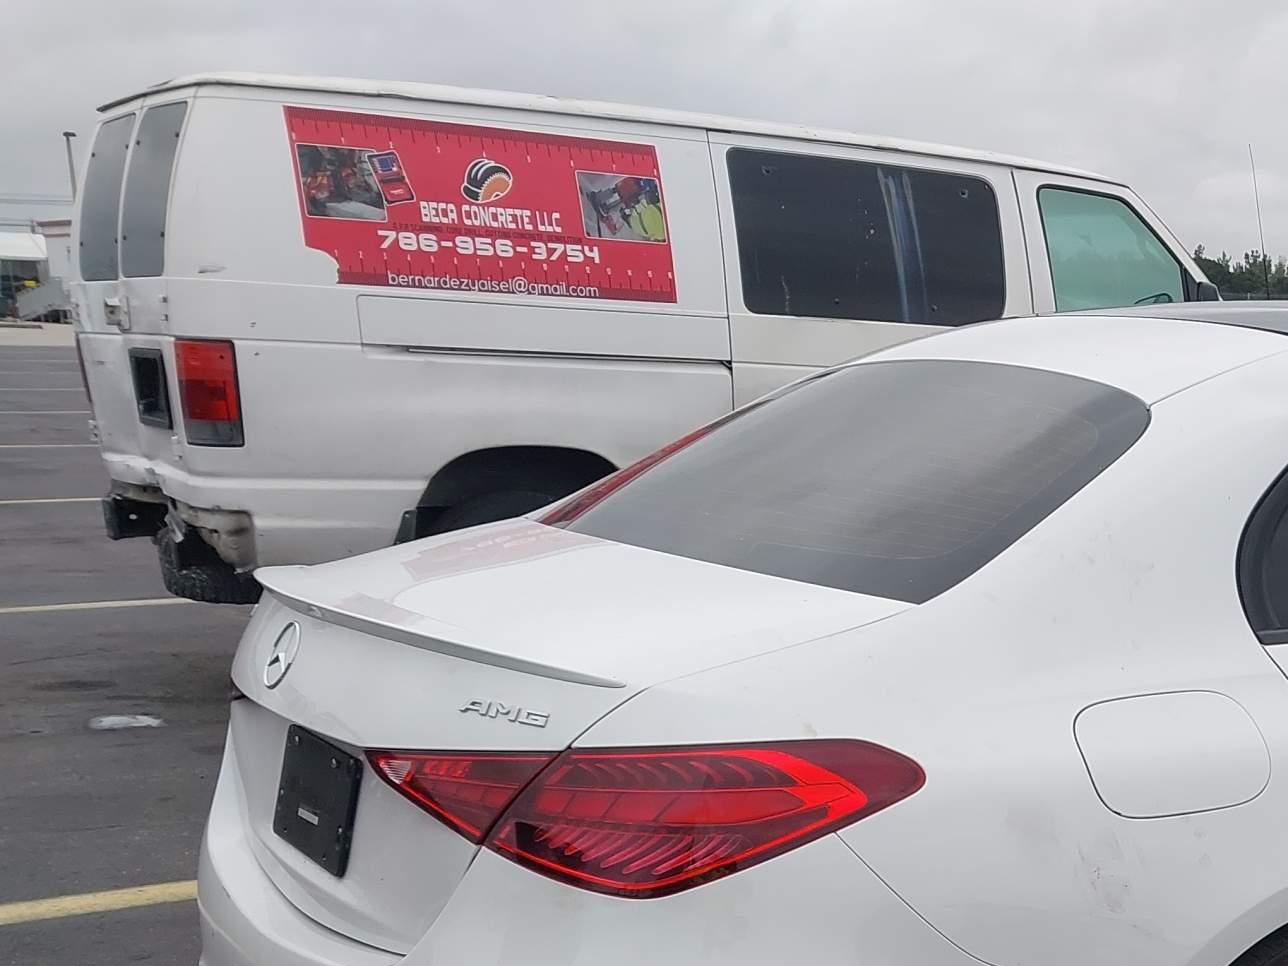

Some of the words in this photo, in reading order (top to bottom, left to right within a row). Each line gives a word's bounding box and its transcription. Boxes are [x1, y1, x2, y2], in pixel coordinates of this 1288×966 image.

[420, 200, 458, 225] BECA
[461, 204, 533, 231] CONCRETE
[536, 210, 562, 233] LLC
[377, 229, 600, 264] 786-956-3754
[387, 270, 600, 297] bernardezyaisel@gmail.com
[458, 698, 550, 728] AMG
